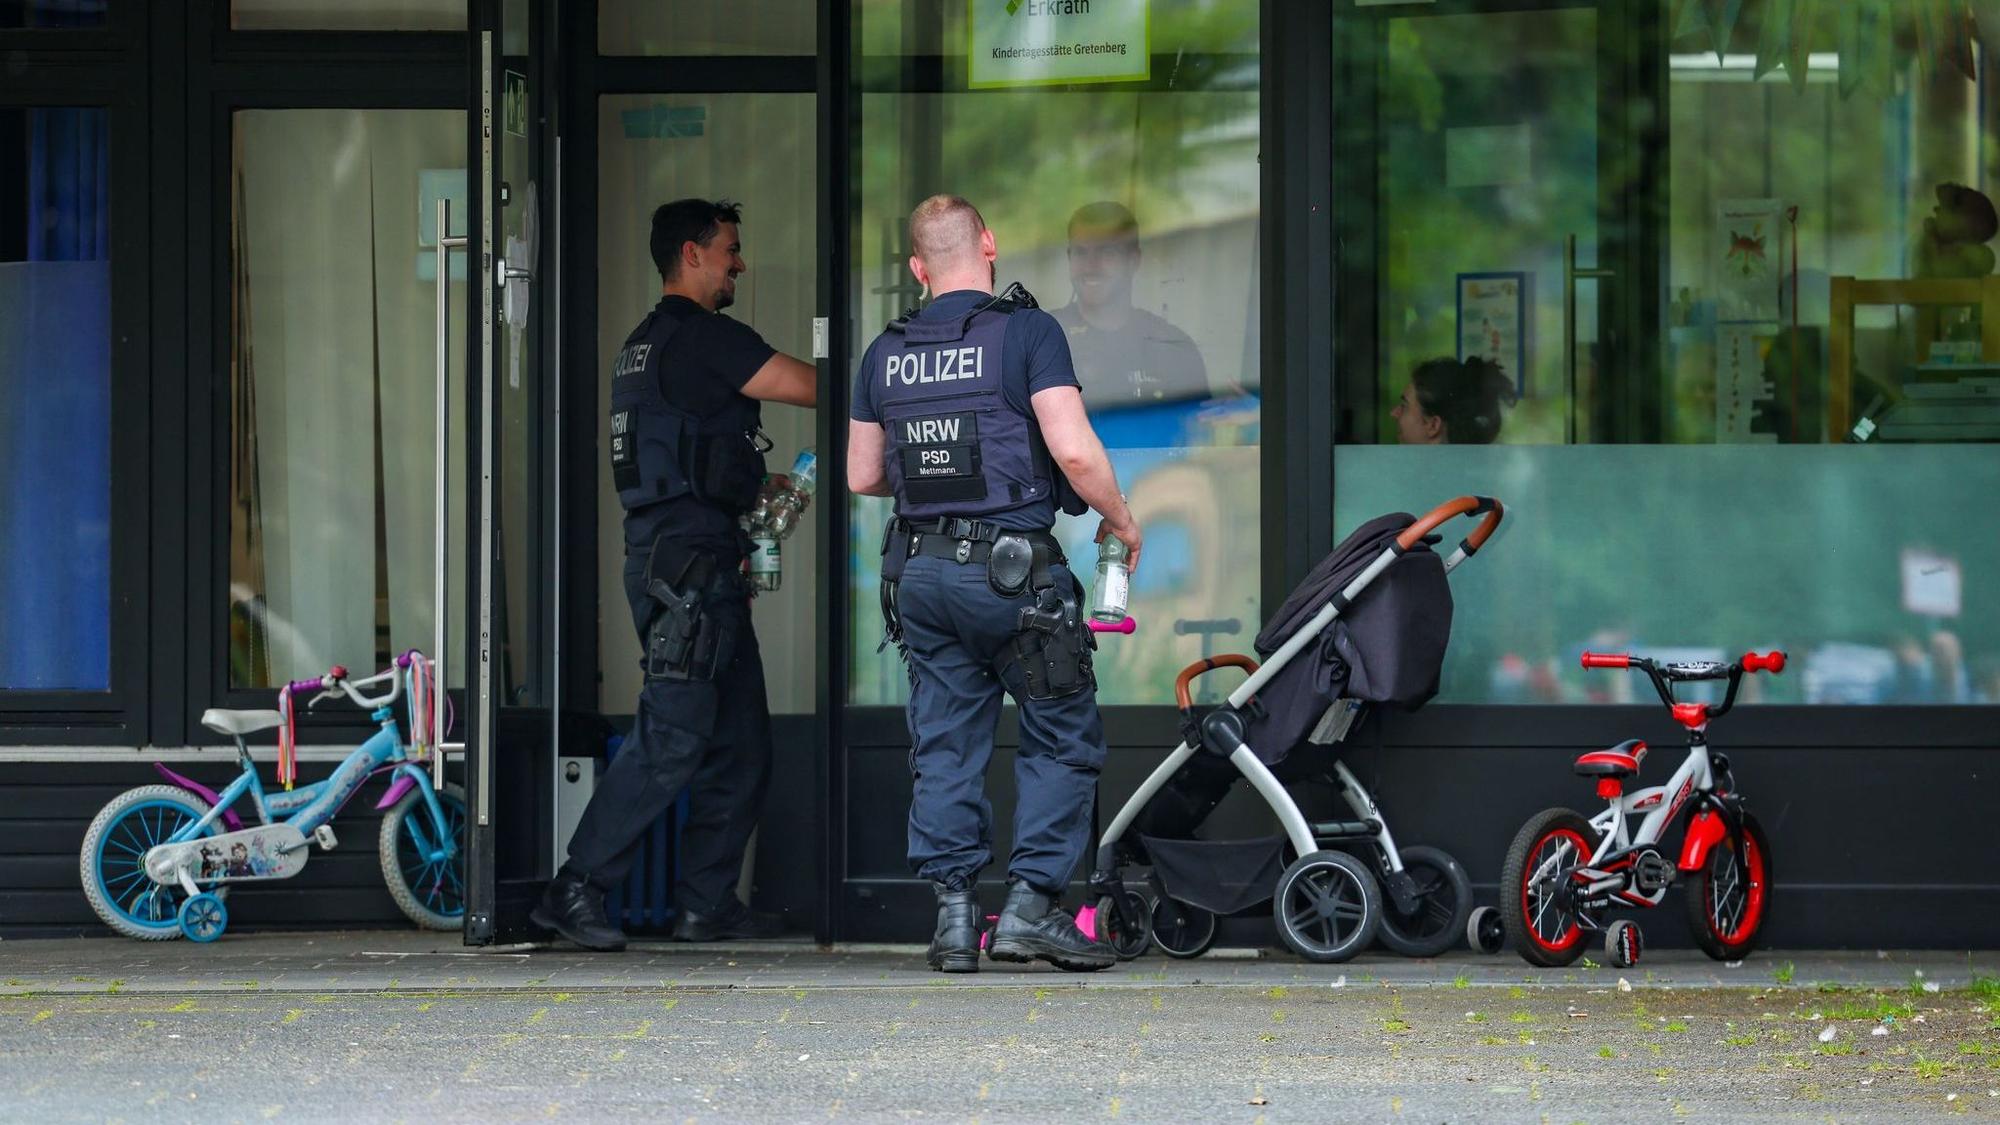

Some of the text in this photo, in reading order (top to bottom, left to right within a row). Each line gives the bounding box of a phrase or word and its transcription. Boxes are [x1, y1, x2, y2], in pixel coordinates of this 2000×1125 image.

[1028, 0, 1090, 16] Erkrath
[992, 42, 1126, 59] Kindertagesstätte Gretenberg
[613, 344, 652, 378] OLIZEI
[886, 346, 983, 387] POLIZEI
[906, 418, 960, 444] NRW
[921, 450, 950, 465] PSD
[919, 467, 956, 476] Mettmann
